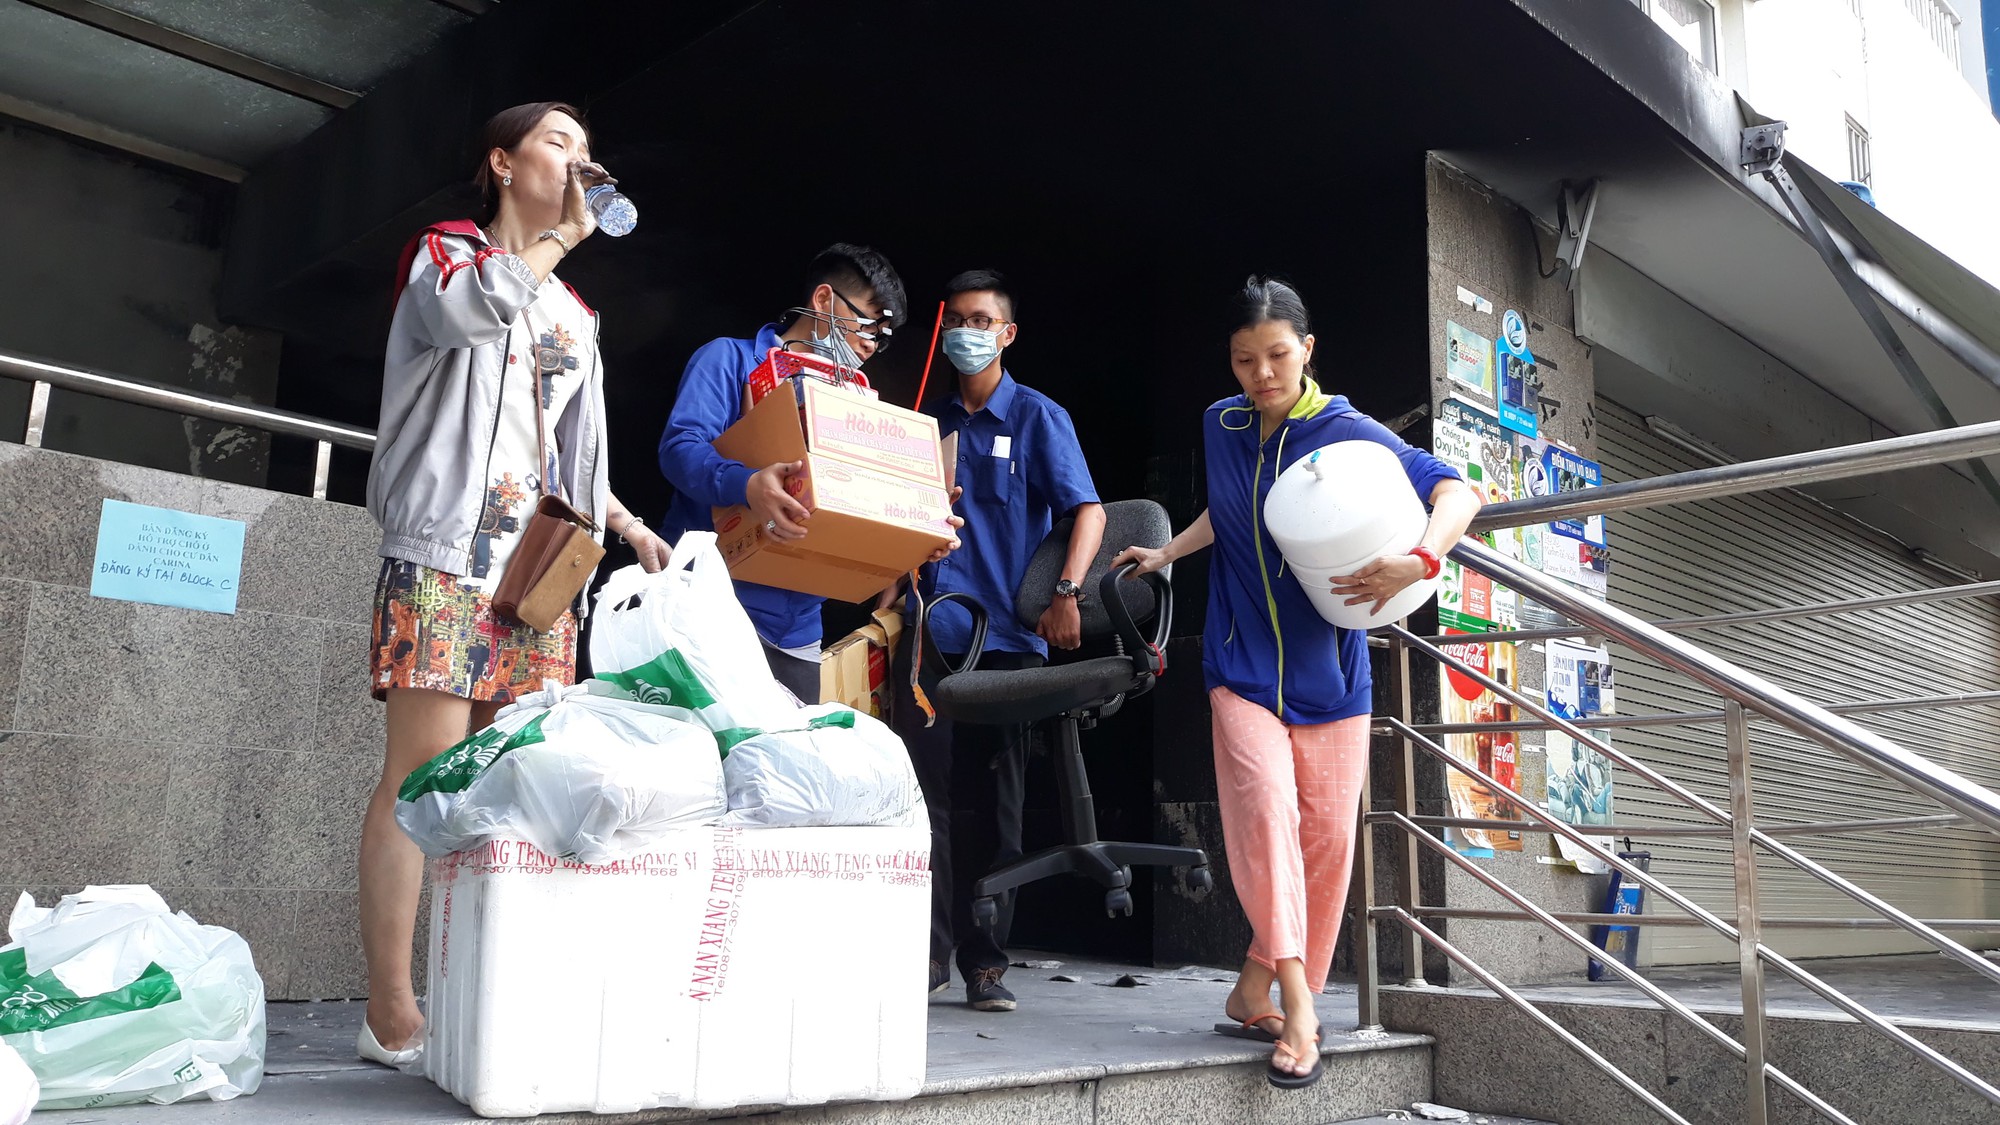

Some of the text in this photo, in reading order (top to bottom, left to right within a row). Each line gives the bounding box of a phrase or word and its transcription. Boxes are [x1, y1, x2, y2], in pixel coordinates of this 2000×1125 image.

[1442, 426, 1461, 445] Chống
[1435, 437, 1452, 456] Oxy
[1454, 443, 1470, 461] hóa
[194, 530, 209, 540] KÝ
[153, 557, 191, 569] CARINA
[159, 547, 181, 557] CHO
[100, 560, 131, 575] ĐĂNG
[137, 564, 152, 578] KÝ
[180, 572, 215, 587] BLOCK
[220, 579, 232, 590] C
[751, 849, 780, 871] NAN
[786, 850, 830, 872] XIANG
[835, 852, 871, 873] TENG
[699, 898, 731, 949] XIANG
[691, 950, 720, 986] NAN
